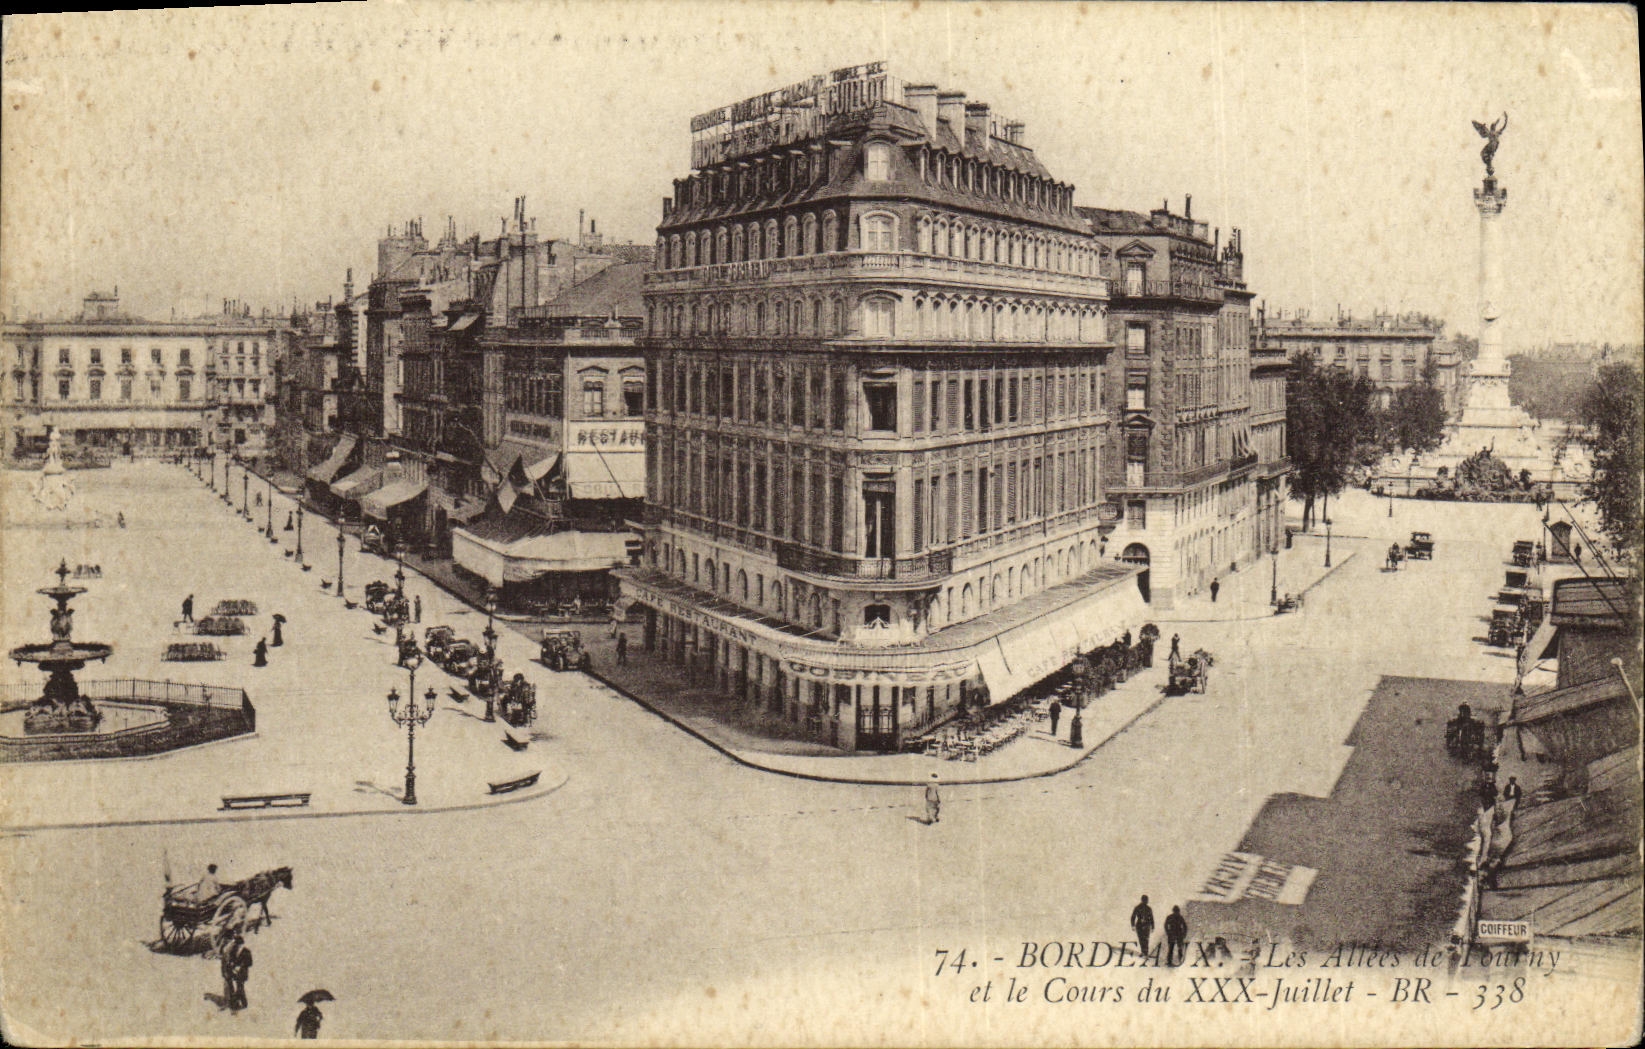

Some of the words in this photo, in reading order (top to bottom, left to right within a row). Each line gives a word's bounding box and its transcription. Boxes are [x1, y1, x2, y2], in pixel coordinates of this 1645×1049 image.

[826, 74, 887, 116] GUILLOT
[670, 602, 758, 645] RESTAURANT
[1480, 923, 1527, 937] COIFFEUR
